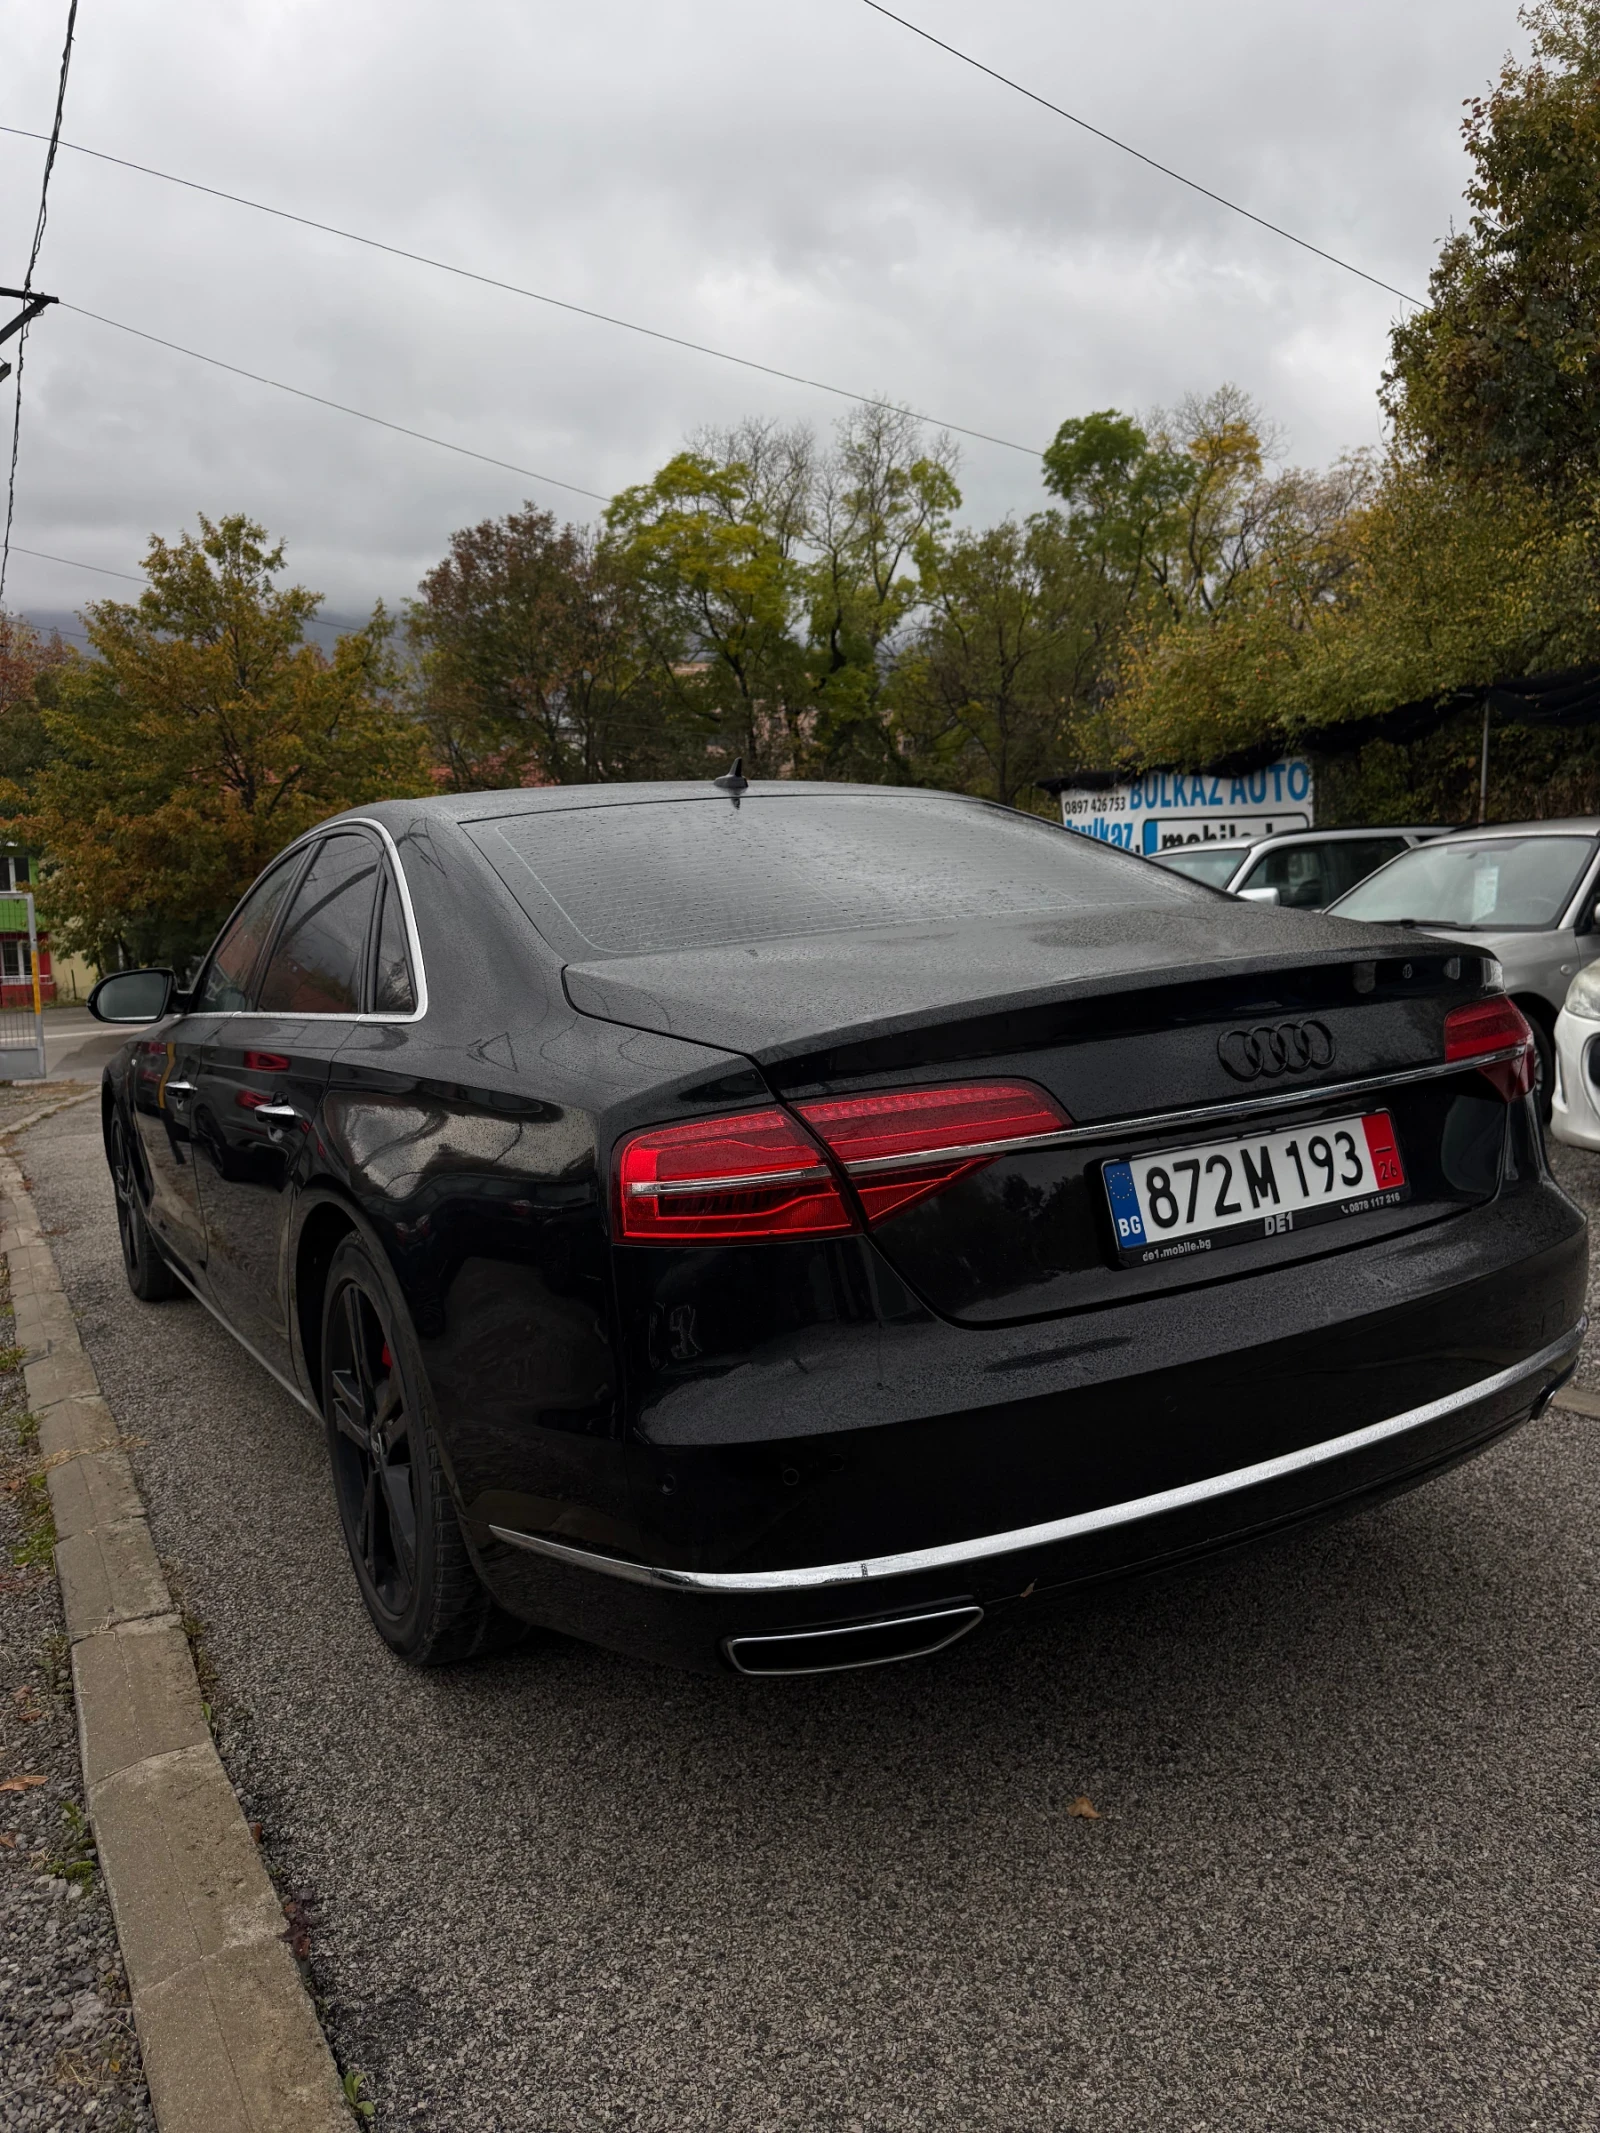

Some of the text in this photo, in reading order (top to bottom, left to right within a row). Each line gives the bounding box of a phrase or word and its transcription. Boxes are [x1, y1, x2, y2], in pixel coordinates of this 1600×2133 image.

[1130, 762, 1310, 810] BULKAZ AUTO
[1065, 800, 1088, 815] 0897
[1378, 1159, 1398, 1180] 26
[1349, 1200, 1369, 1213] 0878
[1371, 1196, 1384, 1207] 117
[1118, 1215, 1142, 1237] BG
[1264, 1212, 1294, 1236] DE1
[1142, 1239, 1212, 1262] de1.mobile.bg
